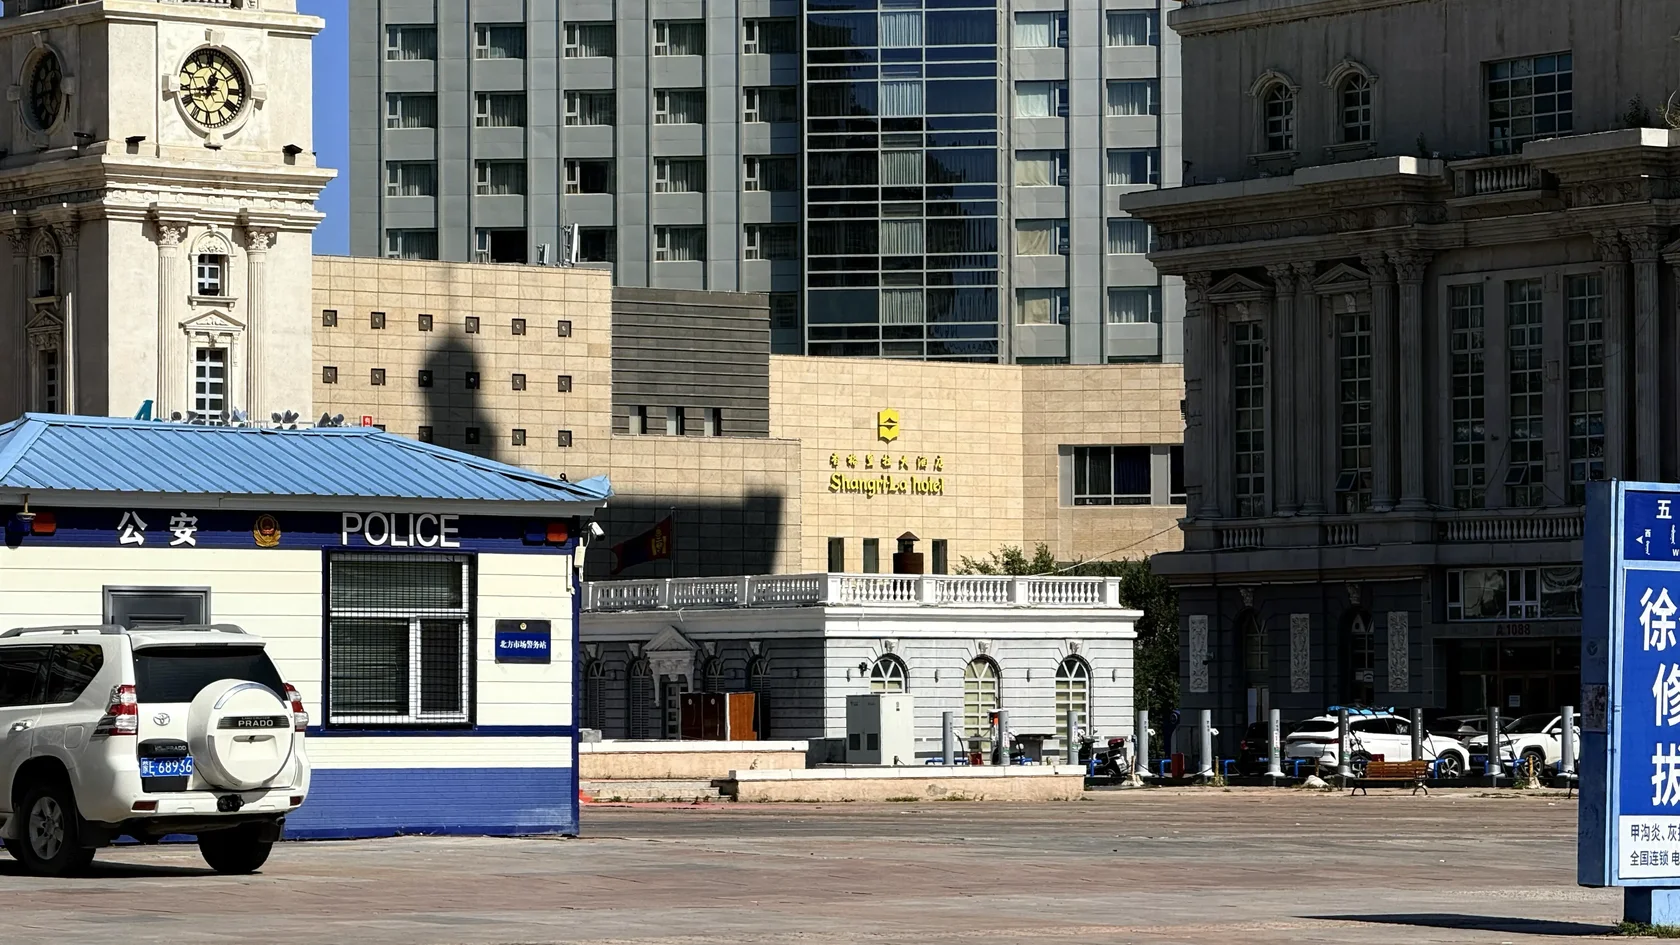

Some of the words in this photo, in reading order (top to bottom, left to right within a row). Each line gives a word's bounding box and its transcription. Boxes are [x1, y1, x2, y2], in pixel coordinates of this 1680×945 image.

[1656, 499, 1672, 519] 五
[117, 511, 198, 546] 公安
[342, 512, 461, 547] POLICE
[499, 639, 547, 649] 北方市场警务站
[238, 719, 274, 727] PRADO
[1631, 823, 1680, 842] 甲沟炎、灰
[1630, 850, 1669, 866] 全国连锁
